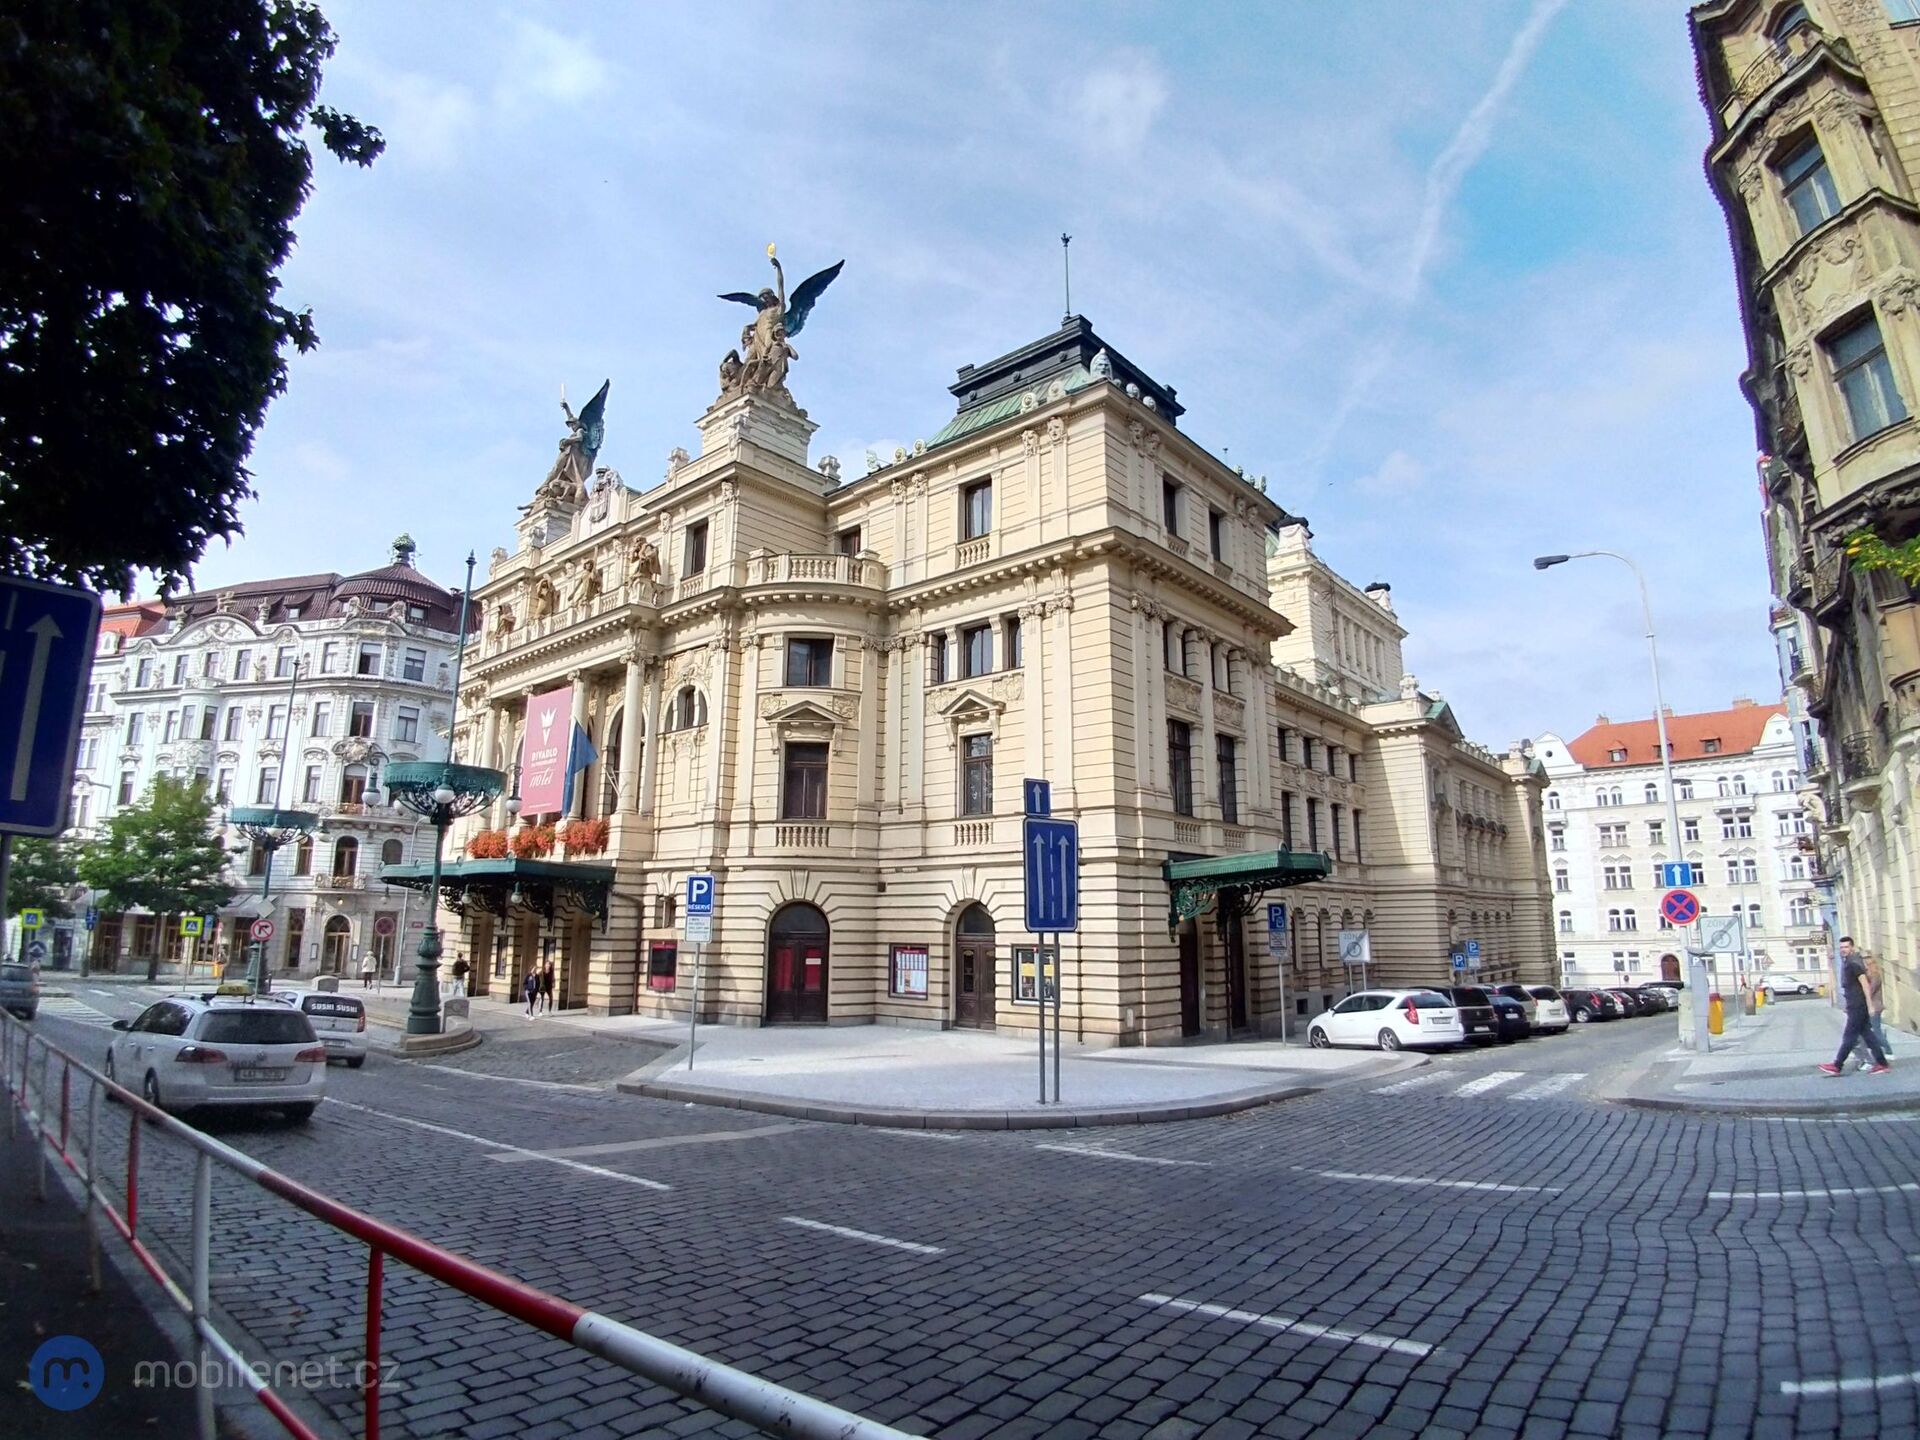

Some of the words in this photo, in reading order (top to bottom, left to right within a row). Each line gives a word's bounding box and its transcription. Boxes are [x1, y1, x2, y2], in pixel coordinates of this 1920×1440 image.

[531, 747, 558, 761] DIVADLO
[692, 879, 708, 902] P
[1271, 906, 1282, 922] P
[1469, 942, 1477, 953] P
[1455, 955, 1464, 966] P
[1692, 956, 1700, 966] P
[336, 1004, 358, 1013] SUSHI
